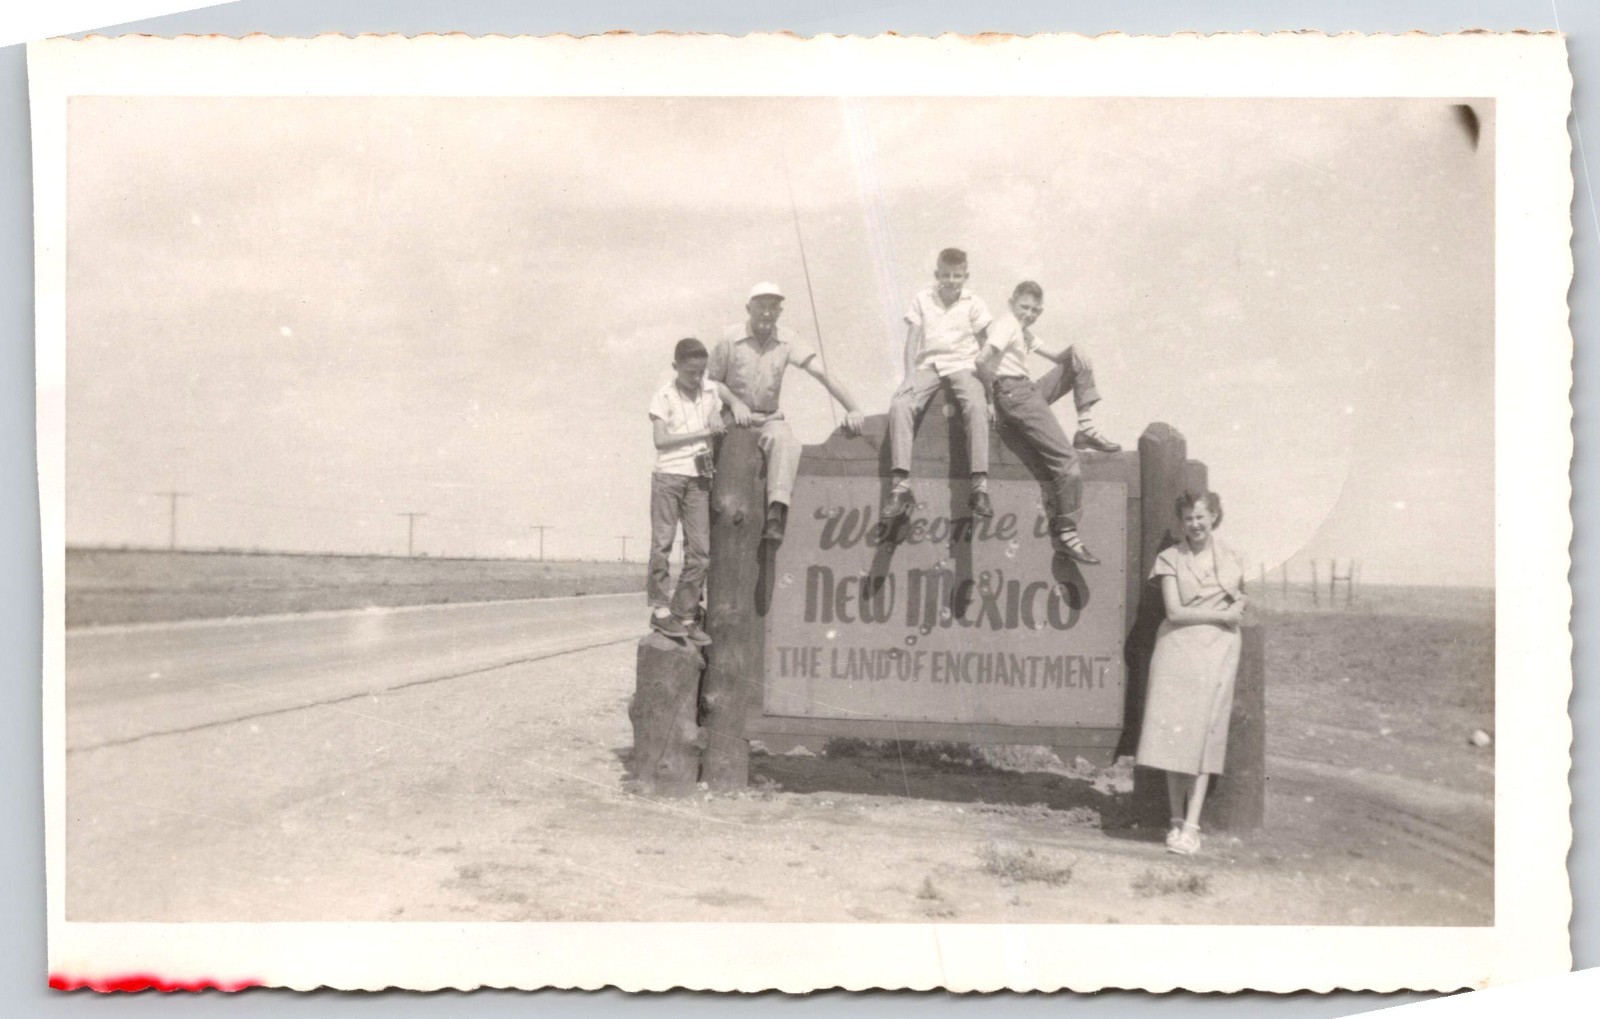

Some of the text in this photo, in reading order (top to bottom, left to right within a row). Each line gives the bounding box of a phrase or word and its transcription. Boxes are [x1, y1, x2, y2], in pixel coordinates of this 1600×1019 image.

[776, 647, 1111, 690] THE LAND OF ENCHANTMENT
